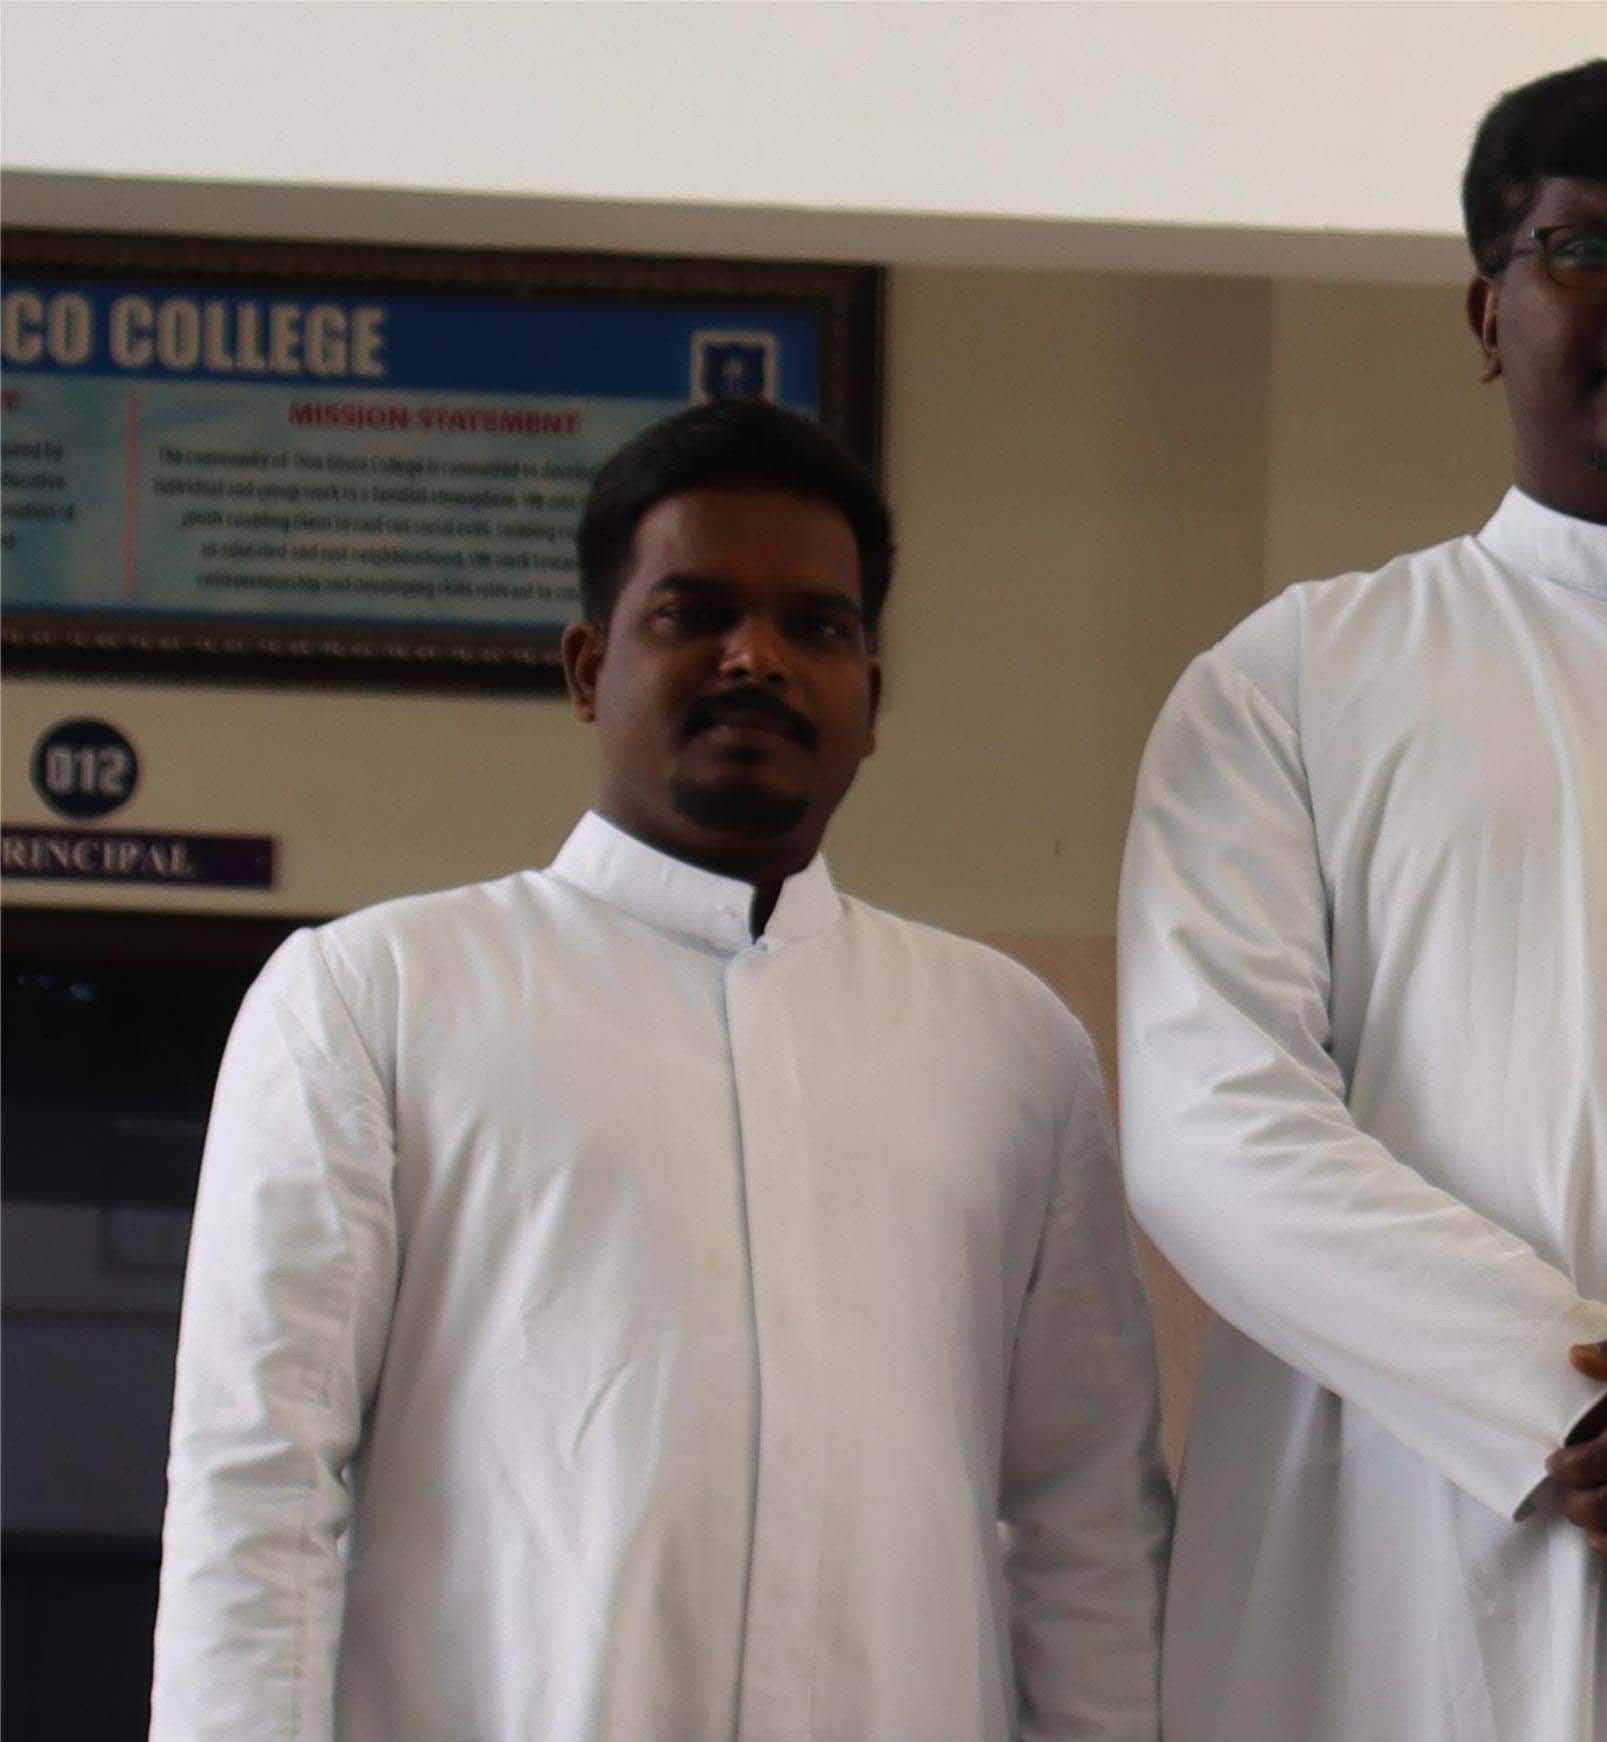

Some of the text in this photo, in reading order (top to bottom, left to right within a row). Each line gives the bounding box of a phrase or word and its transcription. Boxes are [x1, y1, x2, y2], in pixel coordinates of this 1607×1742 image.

[108, 296, 387, 378] COLLEGE
[289, 402, 581, 436] MISSION STATEMENT
[46, 746, 129, 796] 012
